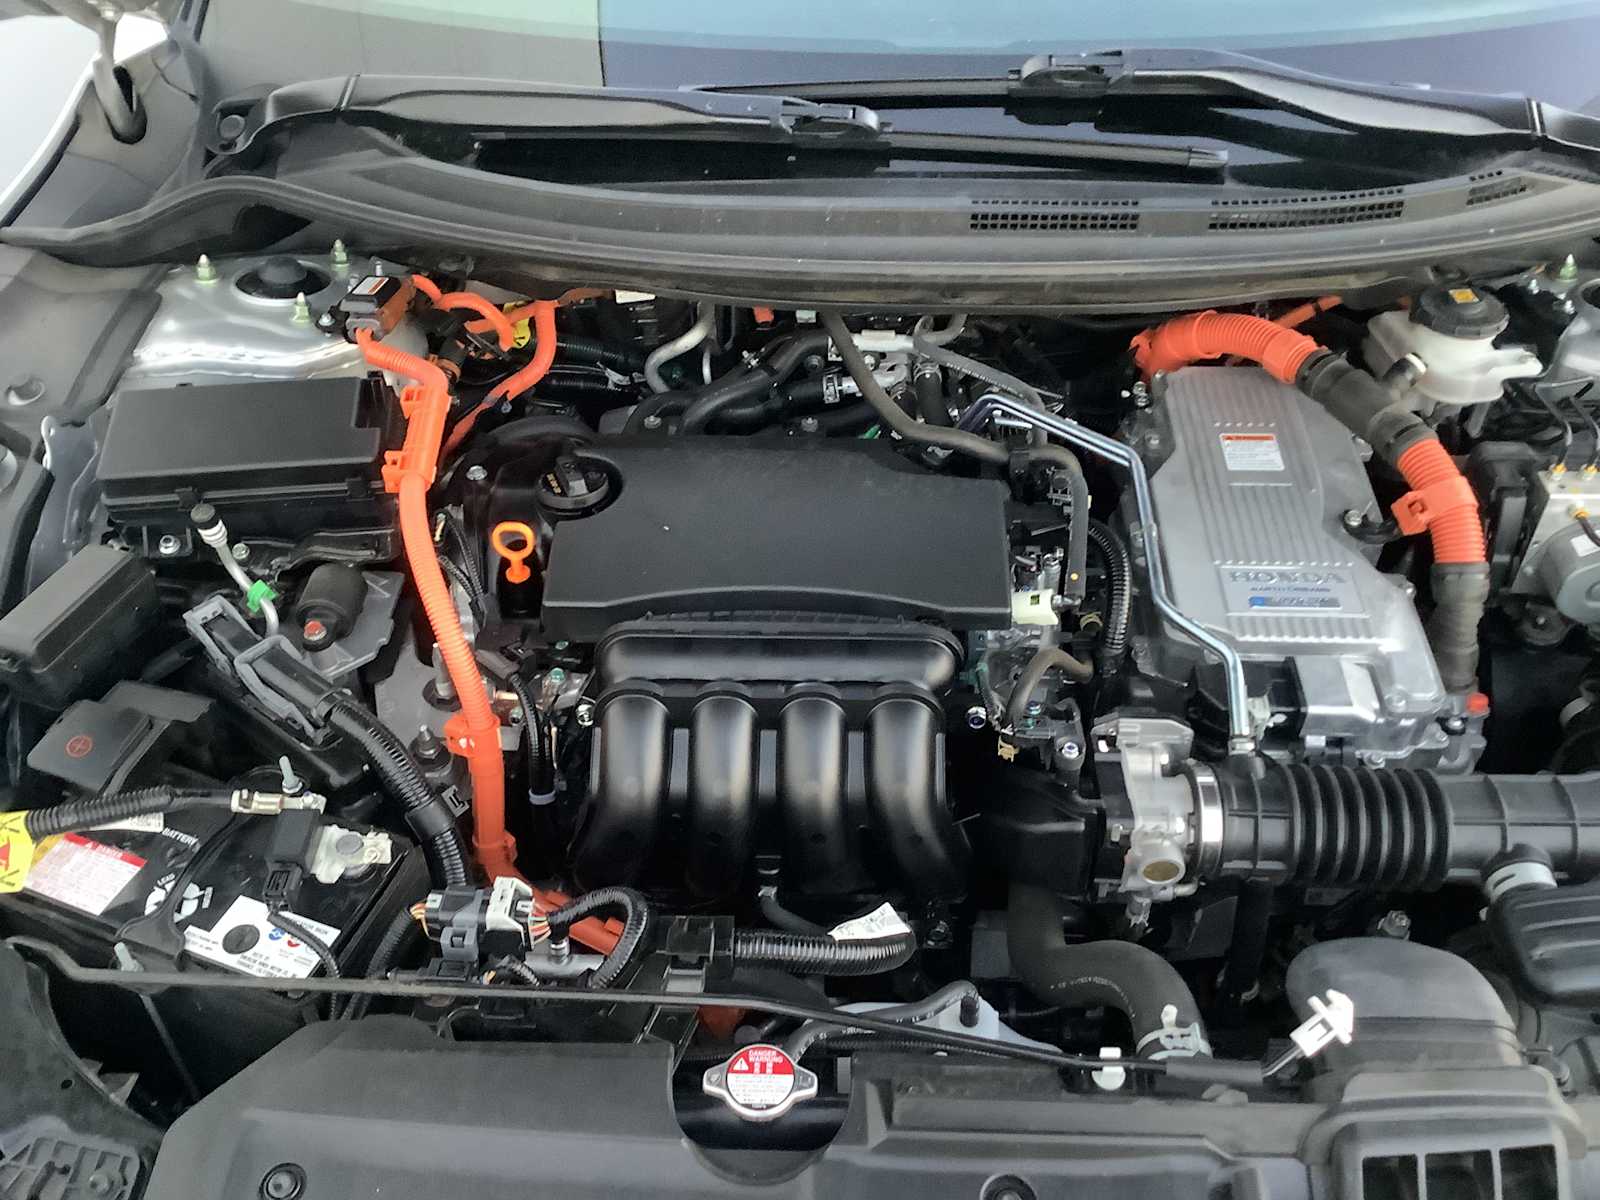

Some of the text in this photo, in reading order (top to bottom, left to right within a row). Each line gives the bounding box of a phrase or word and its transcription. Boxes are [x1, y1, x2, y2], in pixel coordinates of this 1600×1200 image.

[1230, 571, 1345, 584] HONDA
[162, 827, 199, 846] BATTERY
[157, 873, 175, 885] LEAD
[748, 1055, 784, 1063] WARNING
